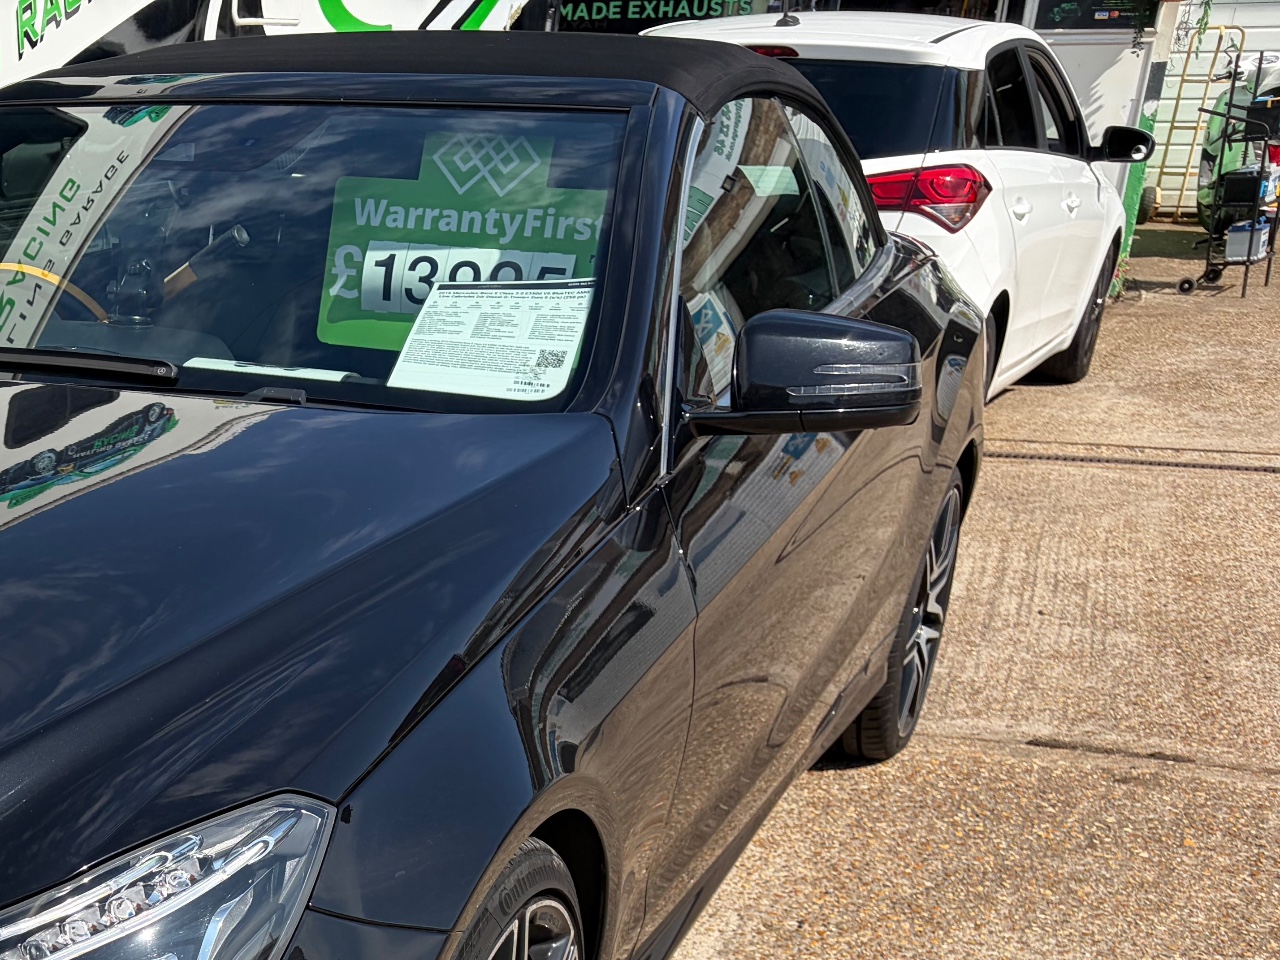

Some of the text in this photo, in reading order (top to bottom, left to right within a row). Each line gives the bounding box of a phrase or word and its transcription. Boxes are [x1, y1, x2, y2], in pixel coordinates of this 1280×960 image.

[559, 0, 753, 21] MADE EXHAUSTS
[354, 197, 604, 244] WarrantyFirst
